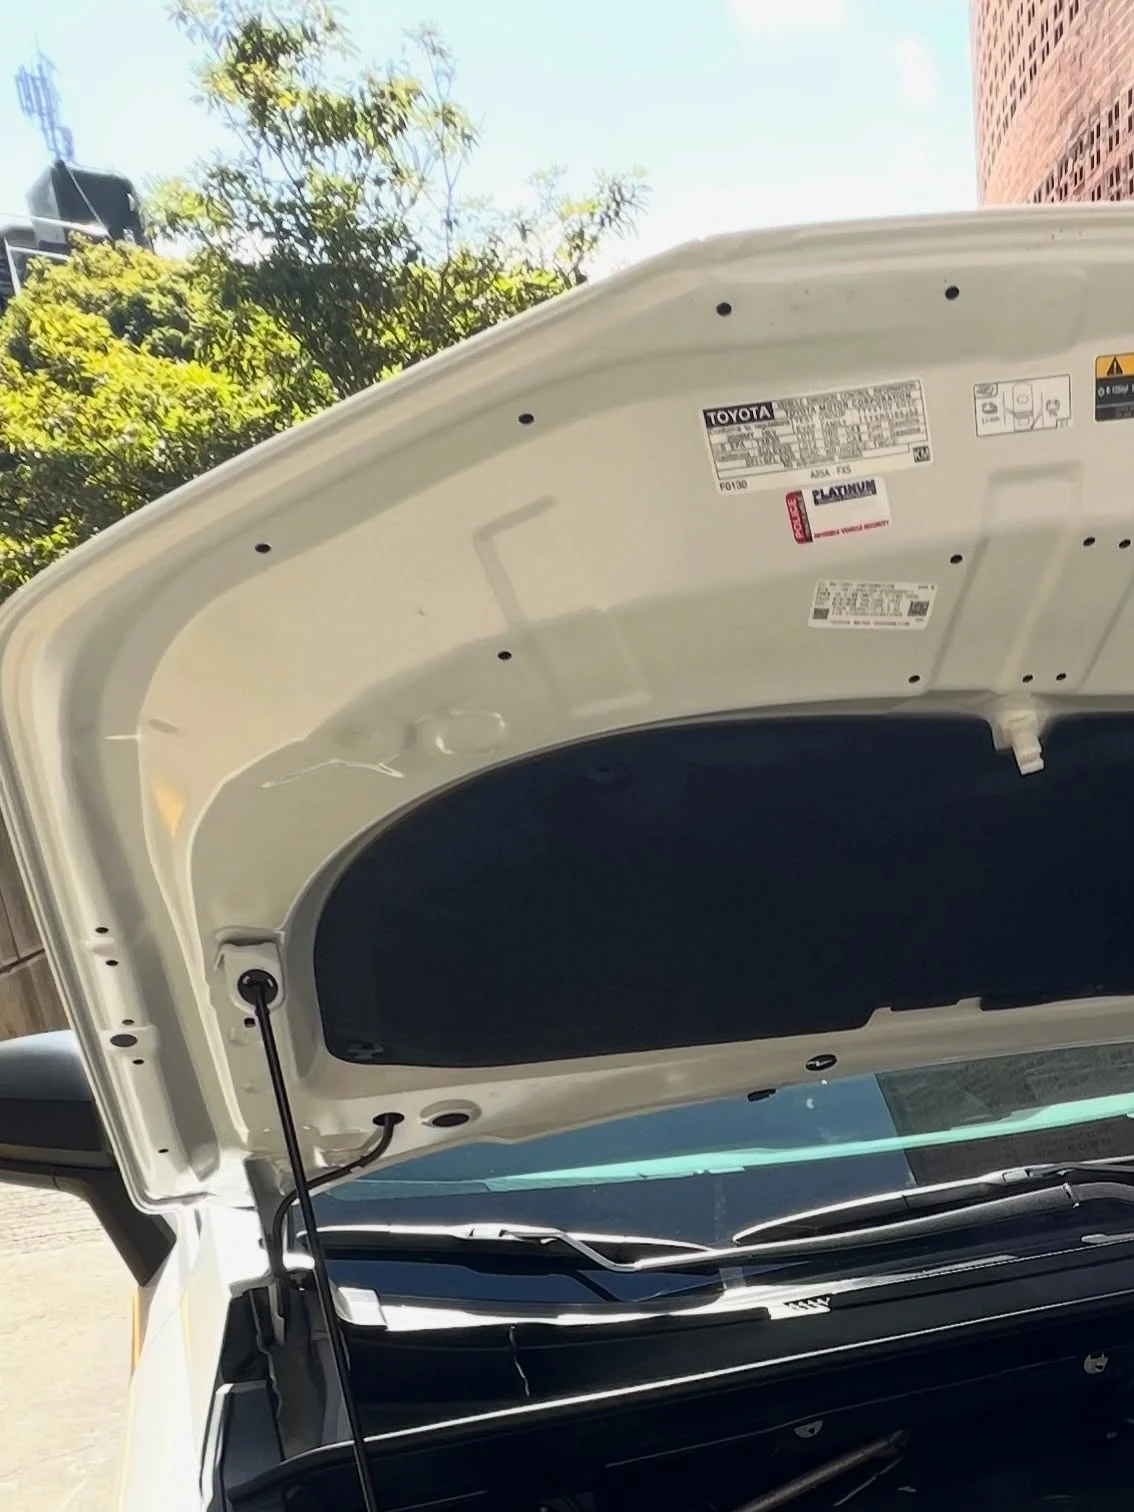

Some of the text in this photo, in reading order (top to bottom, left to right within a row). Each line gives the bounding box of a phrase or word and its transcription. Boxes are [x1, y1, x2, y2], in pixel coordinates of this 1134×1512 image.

[819, 401, 849, 413] MOTOR
[852, 392, 911, 408] CORPORATION
[705, 405, 771, 426] TOYOTA
[720, 480, 748, 492] F0130
[812, 478, 877, 504] PLATINUM
[787, 496, 803, 539] POLICE
